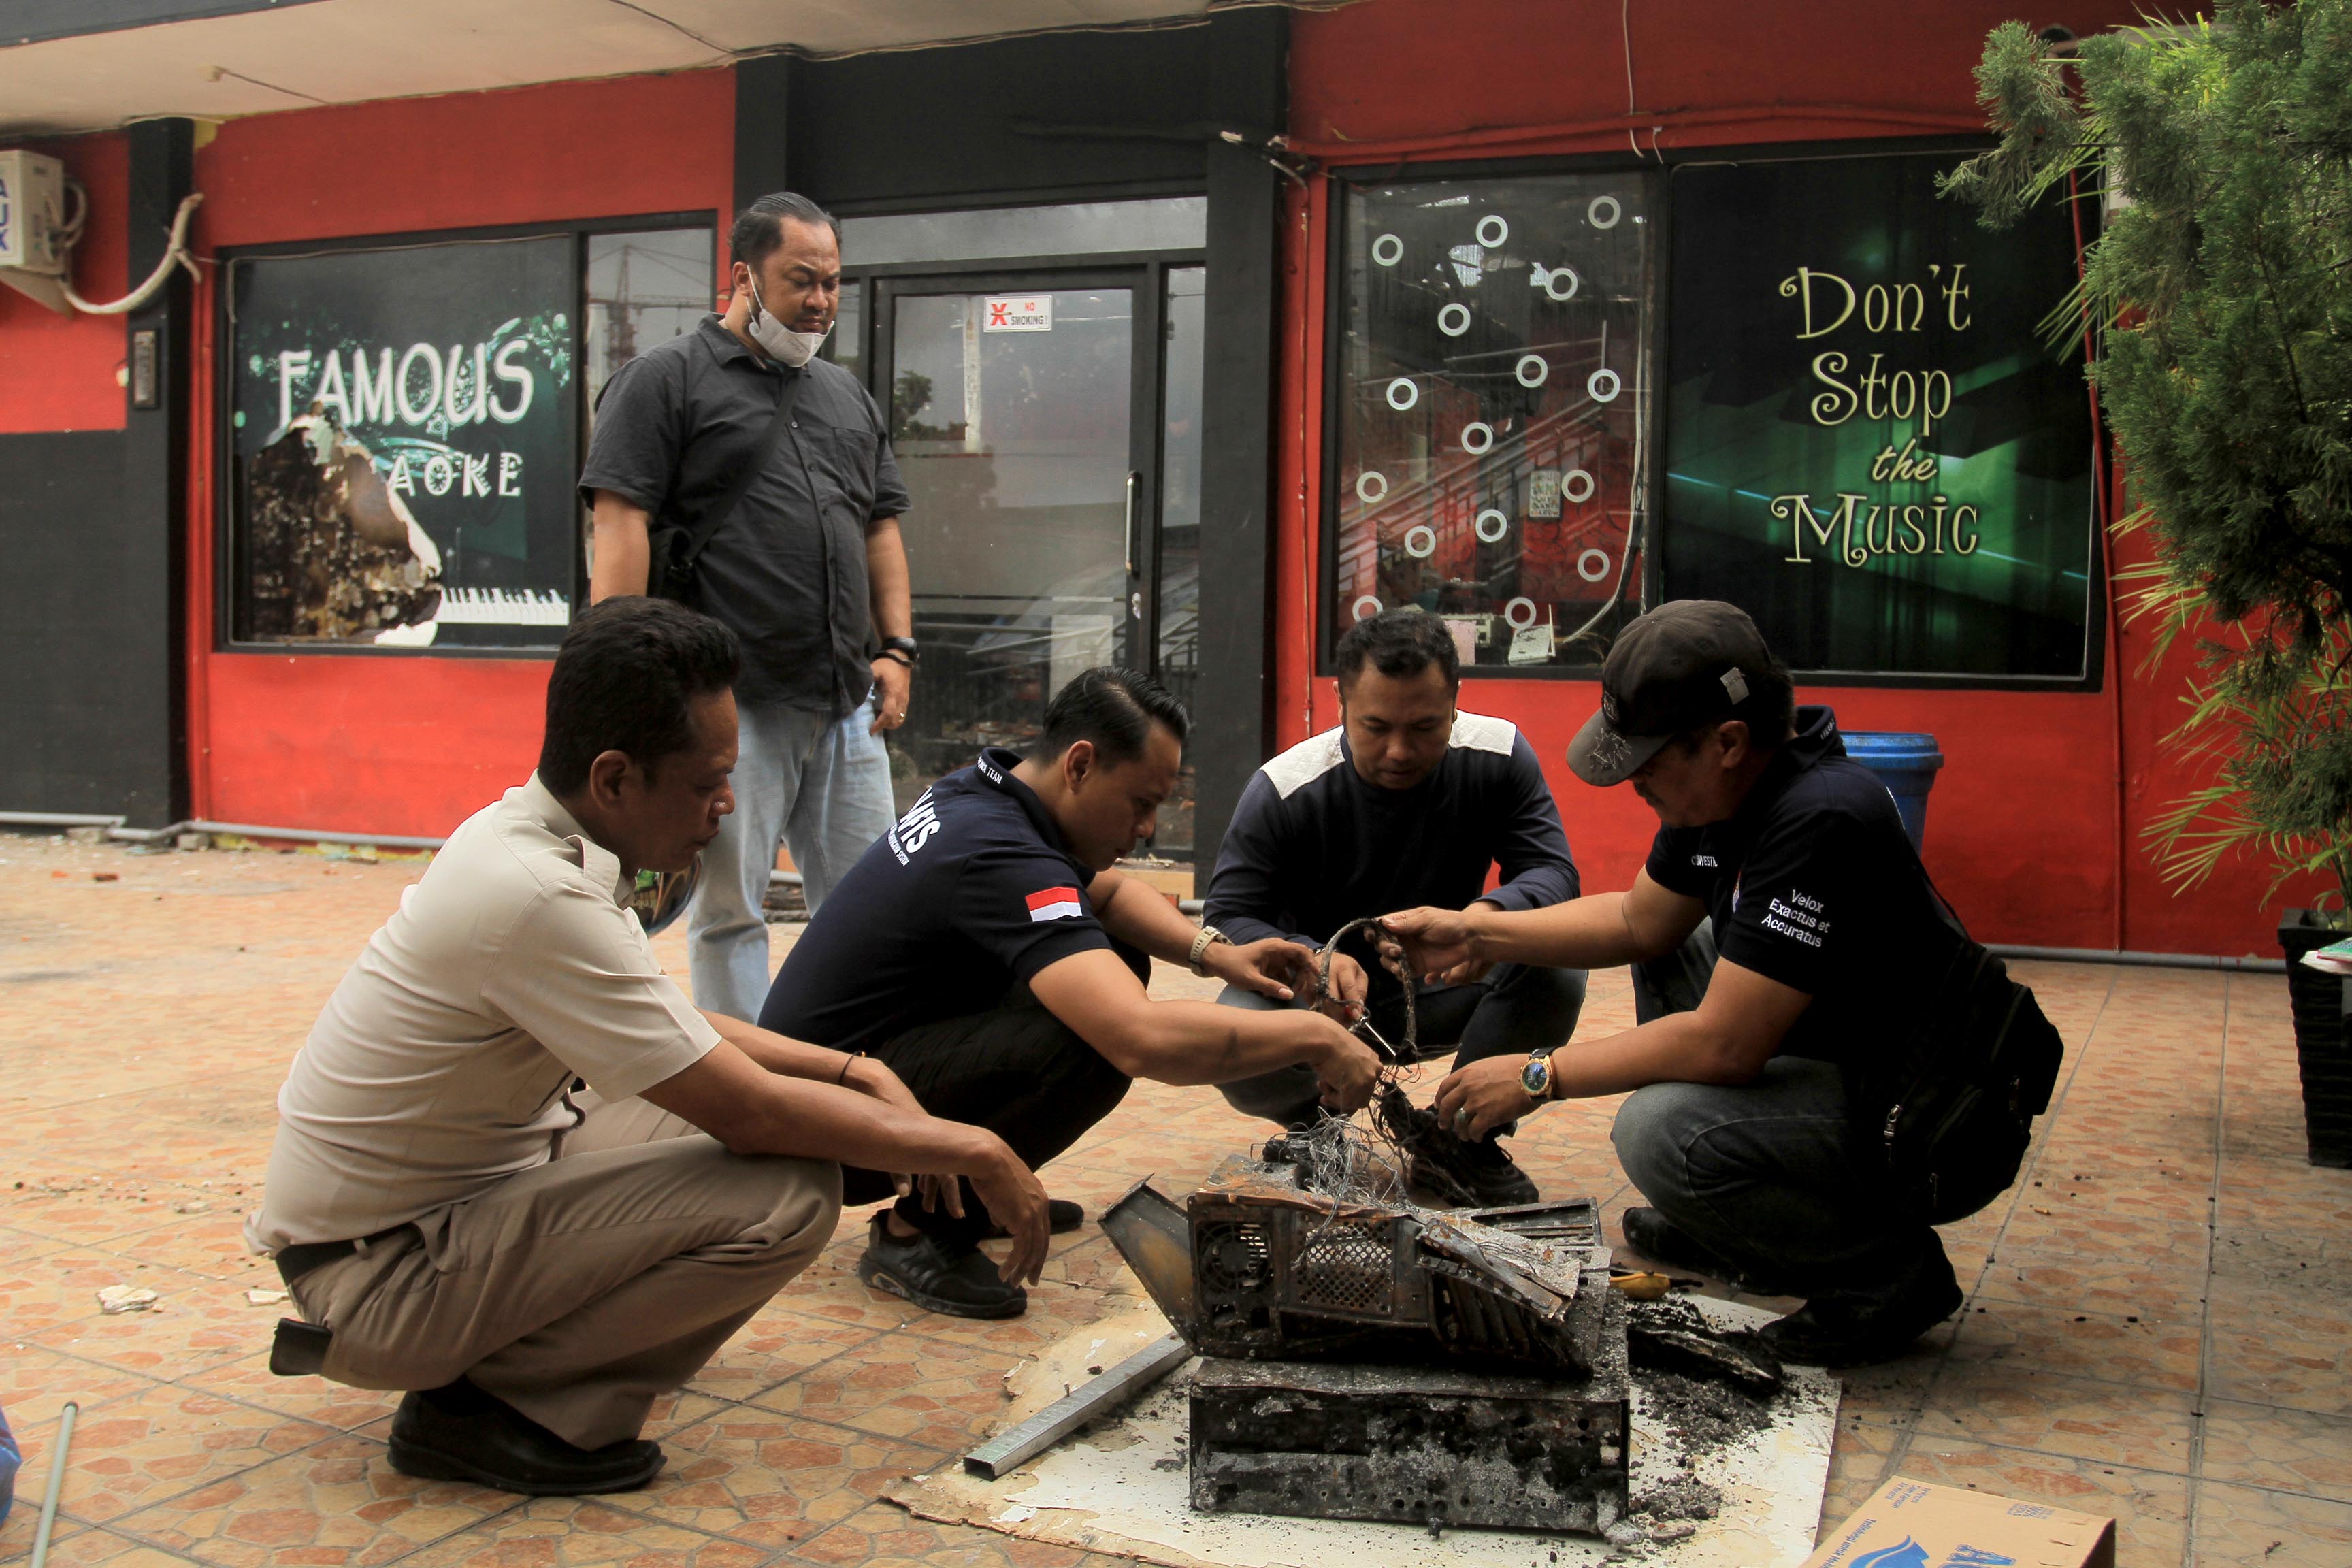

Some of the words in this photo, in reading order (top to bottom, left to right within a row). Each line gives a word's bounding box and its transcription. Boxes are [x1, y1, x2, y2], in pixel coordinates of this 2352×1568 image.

[1024, 301, 1034, 312] NO
[1778, 264, 1971, 339] Don't
[278, 340, 534, 427] FAMOUS
[1810, 351, 1952, 436] Stop
[1872, 438, 1938, 483] the
[1771, 493, 1978, 568] Music
[987, 767, 1002, 784] TEAM
[1769, 898, 1816, 928] Exactus
[1818, 921, 1831, 933] et
[1791, 889, 1824, 914] Velox
[1761, 913, 1822, 947] Accuratus
